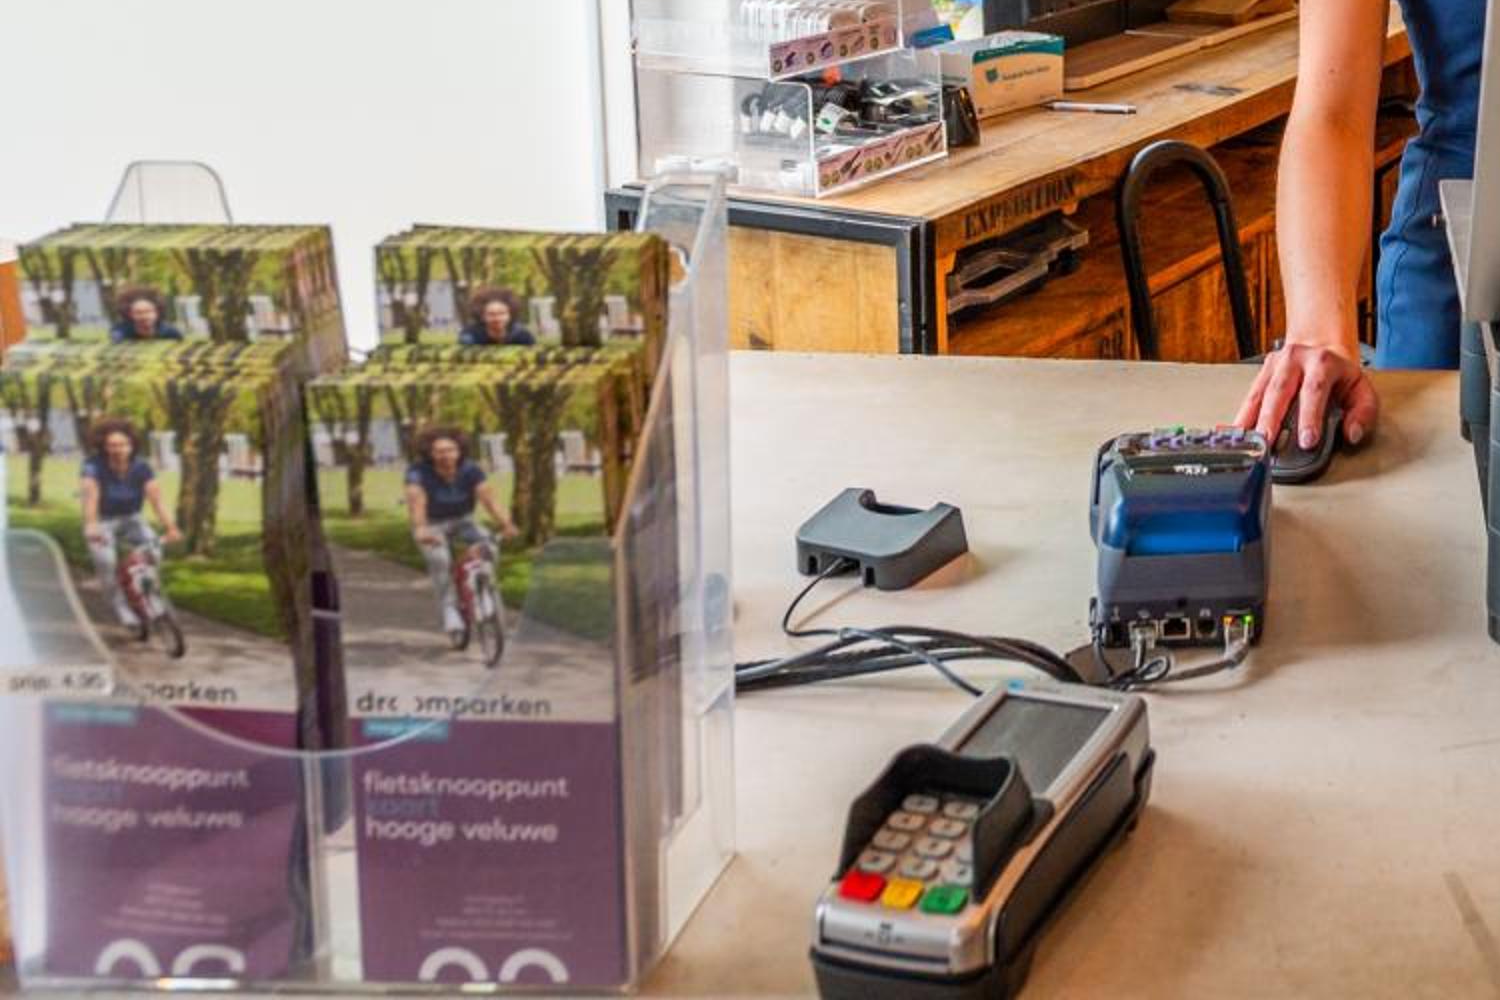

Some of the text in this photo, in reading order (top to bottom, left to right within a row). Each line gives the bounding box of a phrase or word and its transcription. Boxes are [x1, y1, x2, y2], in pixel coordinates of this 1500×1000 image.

[964, 173, 1077, 239] EXPEDITION
[363, 769, 570, 801] fietsknooppunt
[146, 805, 243, 828] veluwe
[365, 817, 559, 846] hooge veluwe
